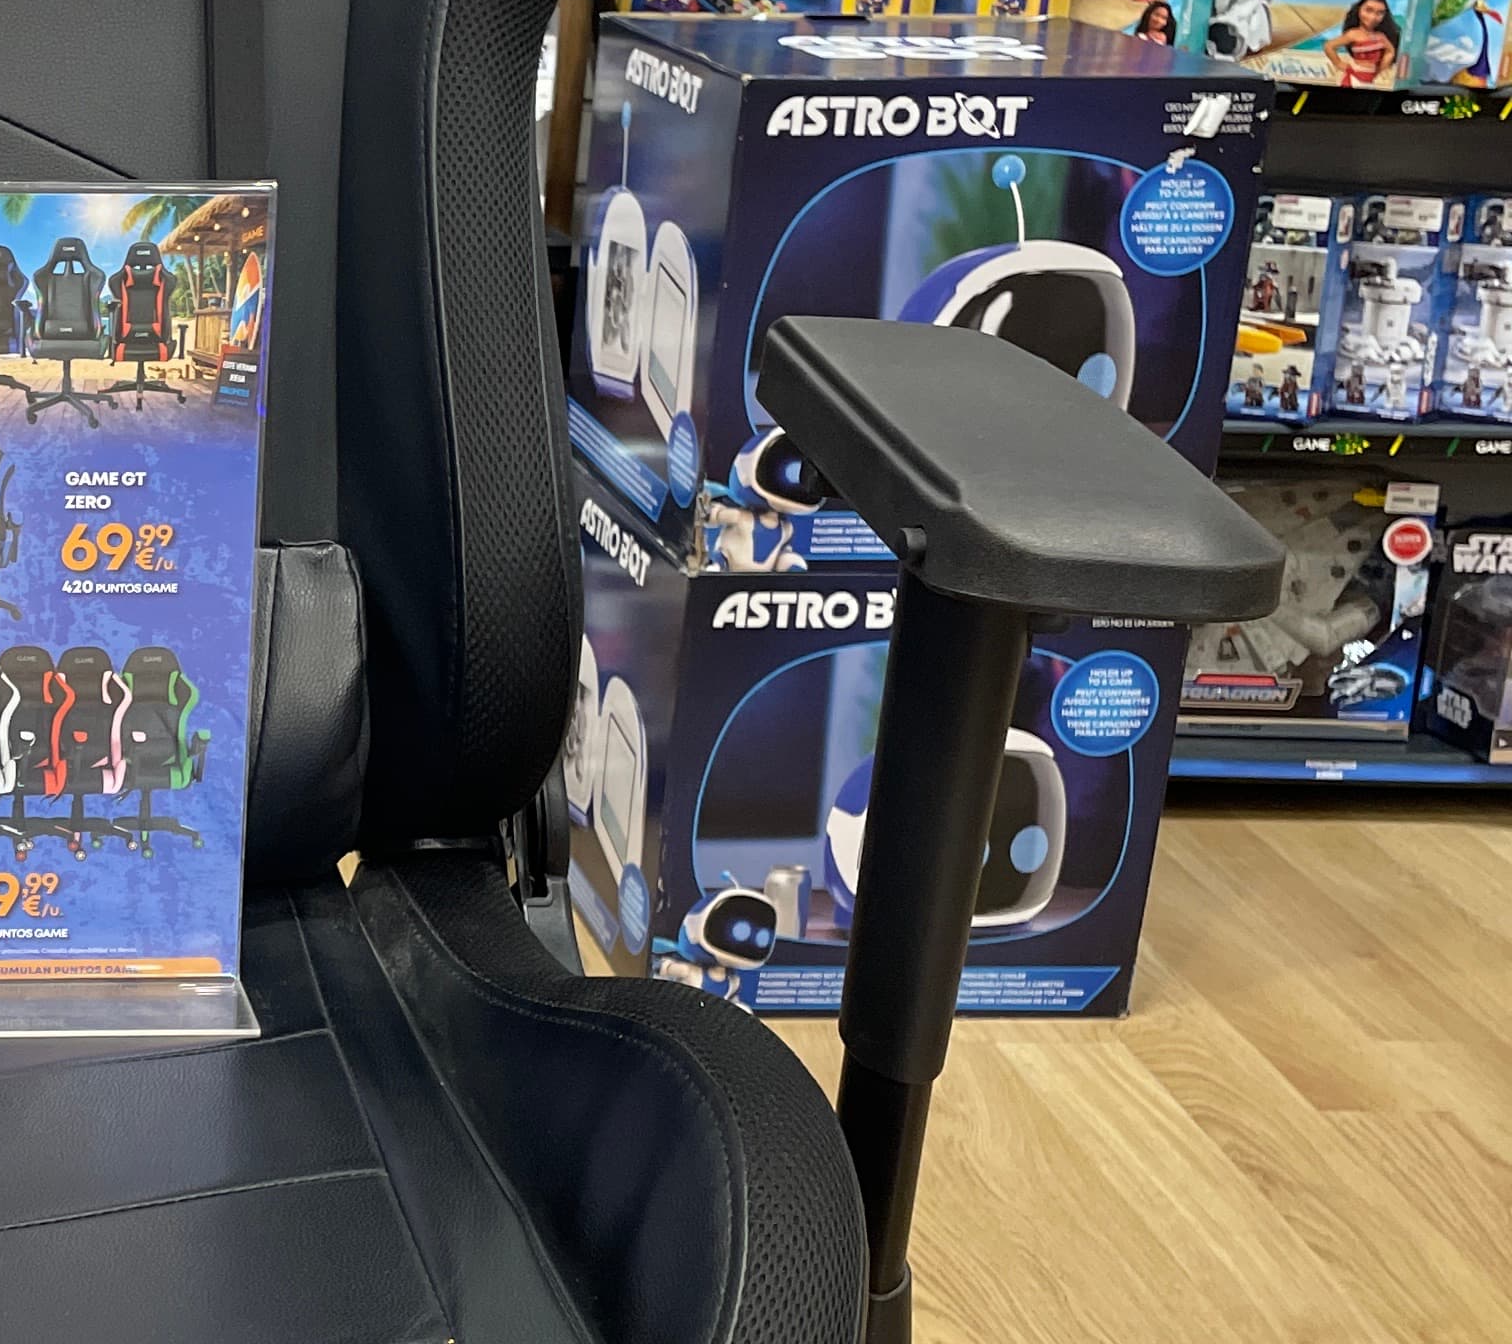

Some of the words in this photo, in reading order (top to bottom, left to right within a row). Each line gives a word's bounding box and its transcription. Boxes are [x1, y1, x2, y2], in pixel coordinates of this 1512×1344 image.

[625, 47, 670, 99] ASTRO
[668, 64, 704, 114] BOT
[766, 95, 921, 137] ASTRO
[925, 92, 1030, 140] BOT
[1292, 436, 1331, 453] GAME
[65, 471, 119, 487] GAME
[121, 471, 147, 487] GT
[64, 494, 112, 510] ZERO
[580, 498, 620, 558] ASTRO
[618, 531, 651, 587] BOT
[61, 580, 94, 595] 420
[95, 582, 141, 594] PUNTOS
[143, 582, 179, 594] GAME
[712, 590, 859, 630] ASTRO
[34, 927, 68, 940] GAME
[54, 965, 101, 975] PUNTOS
